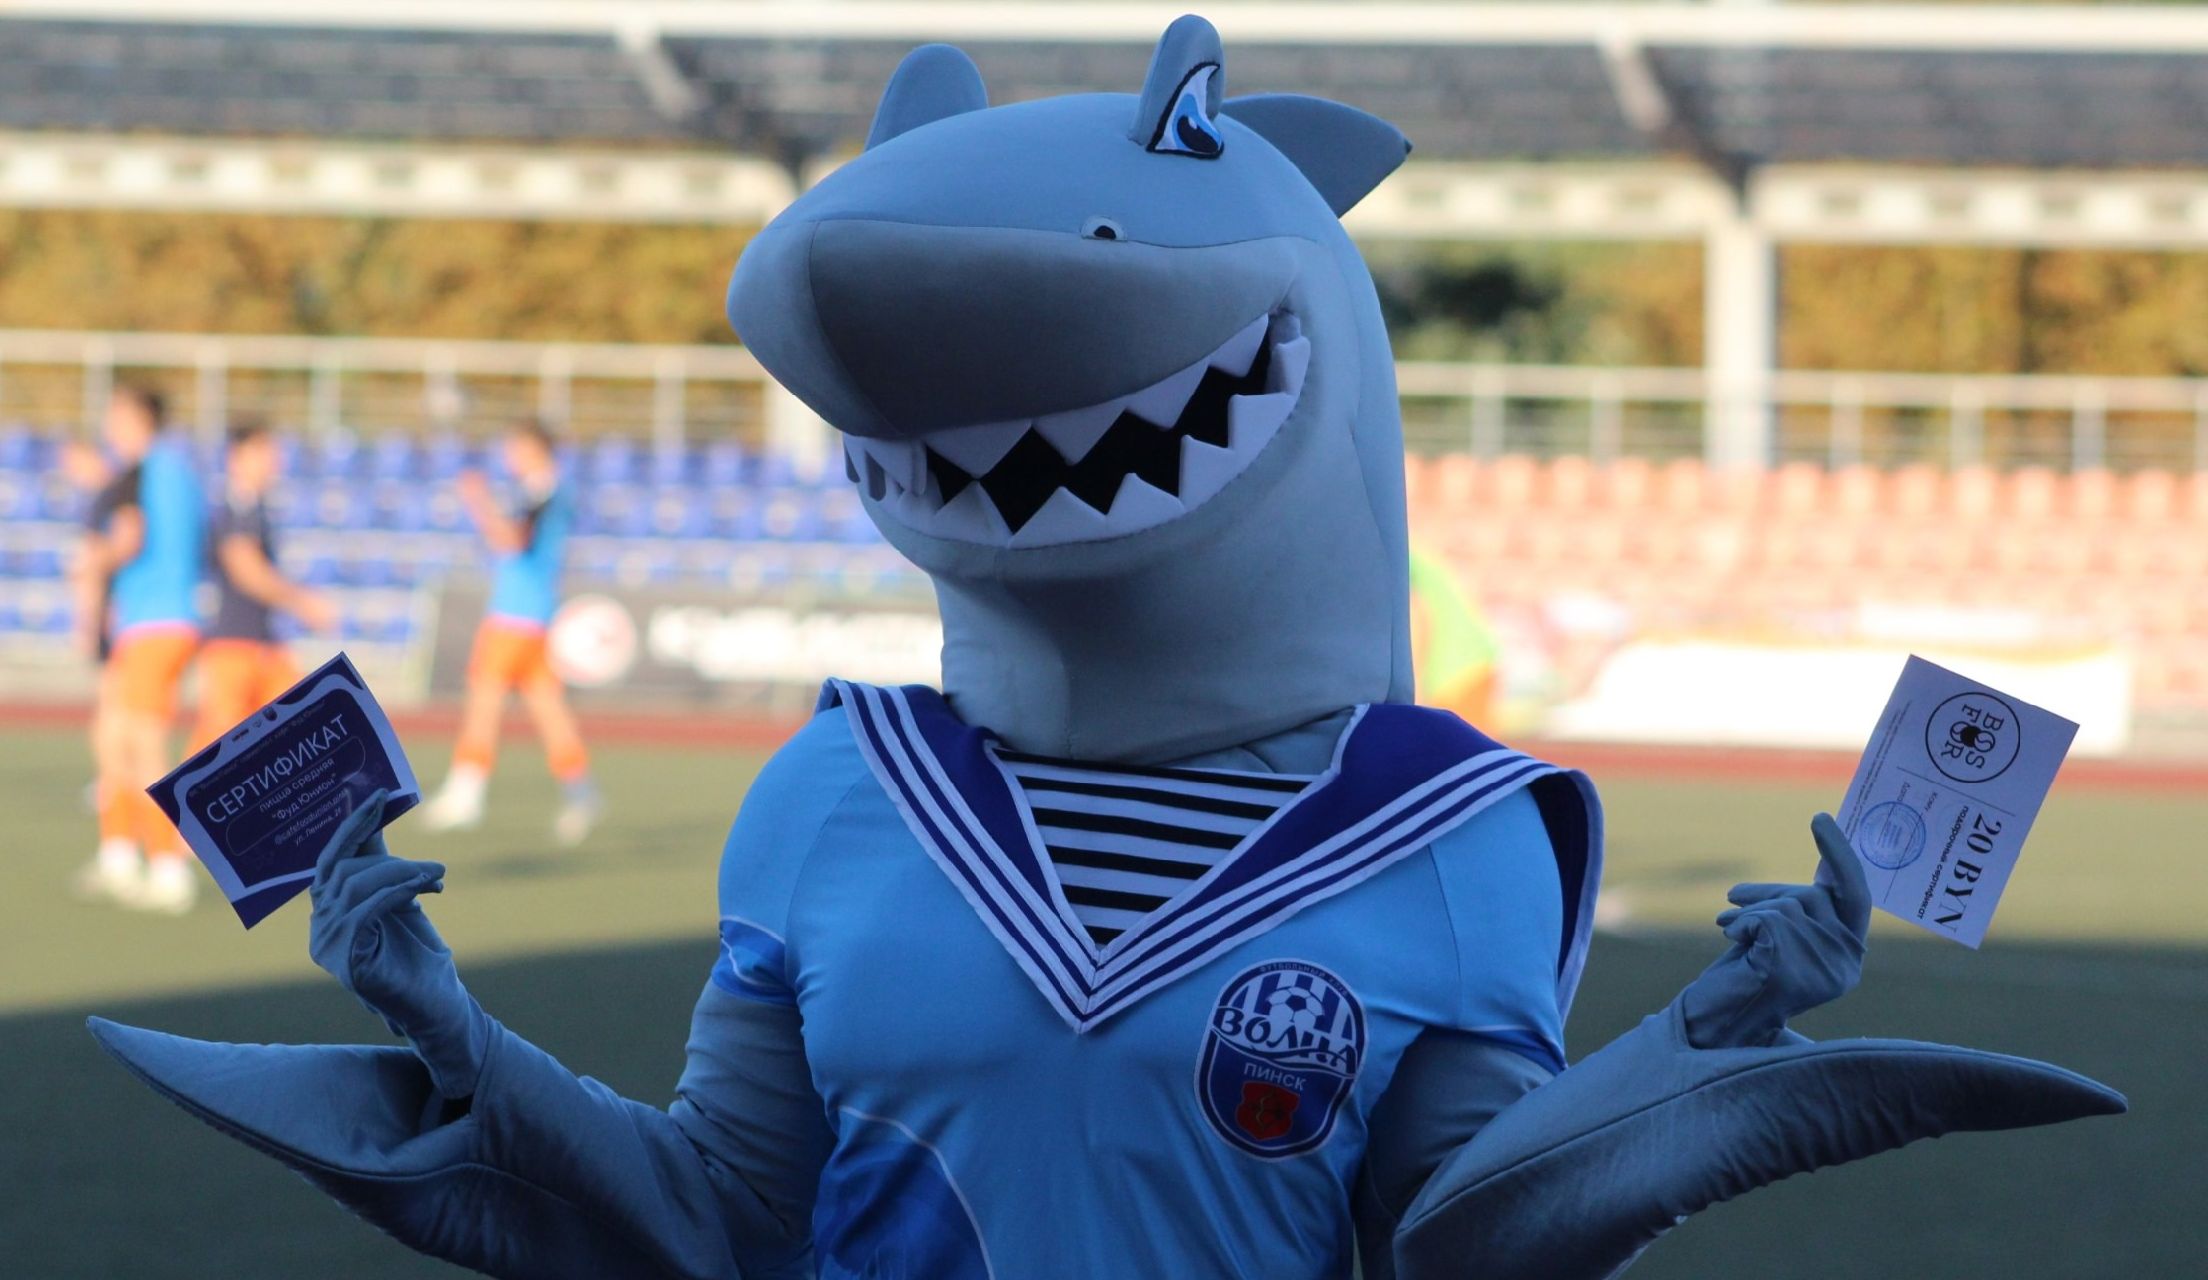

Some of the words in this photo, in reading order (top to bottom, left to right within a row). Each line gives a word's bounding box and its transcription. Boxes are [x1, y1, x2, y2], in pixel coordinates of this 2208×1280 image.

[206, 713, 350, 824] СЕРТИФИКАТ
[259, 787, 292, 813] пицца
[291, 758, 335, 788] средняя
[1966, 813, 2002, 854] 20
[1917, 864, 1943, 919] сертификат
[1934, 859, 1983, 933] BYN
[1243, 1062, 1307, 1091] ПИНСК
